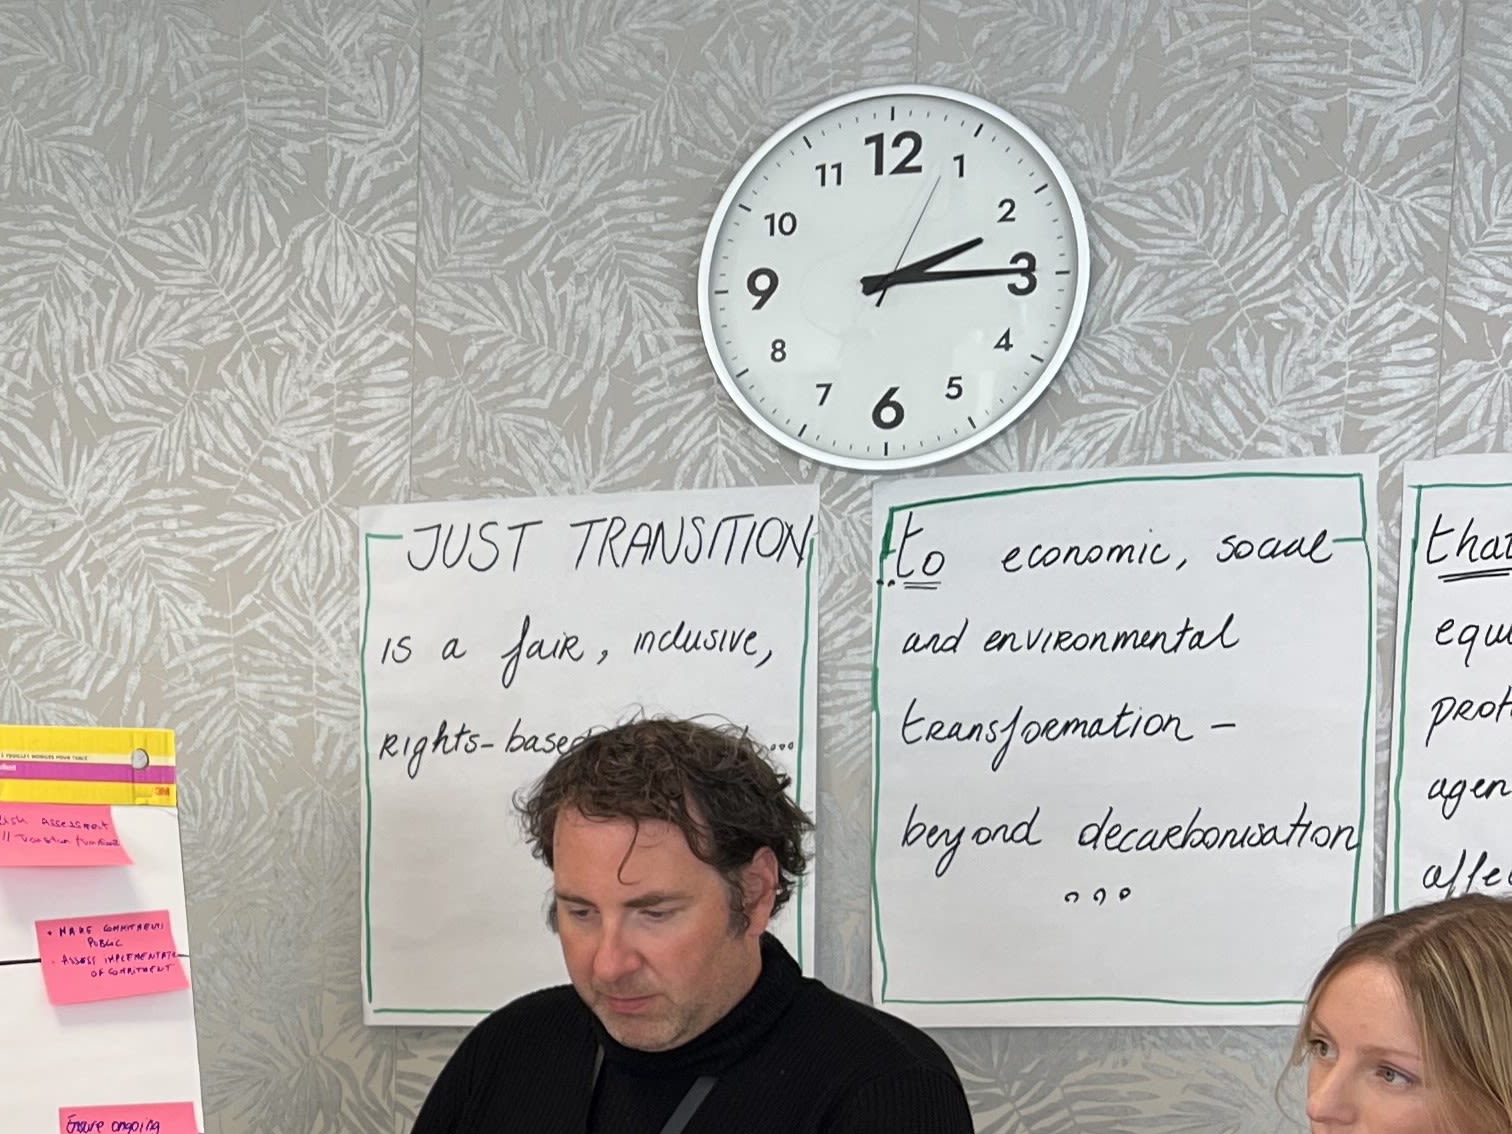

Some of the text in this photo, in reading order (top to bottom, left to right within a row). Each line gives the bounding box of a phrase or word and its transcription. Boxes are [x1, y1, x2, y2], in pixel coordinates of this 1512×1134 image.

[864, 131, 923, 176] 12
[953, 154, 965, 178] 1
[814, 162, 843, 188] 11
[763, 211, 797, 237] 10
[996, 198, 1016, 223] 2
[746, 267, 779, 310] 9
[1007, 251, 1037, 296] 3
[770, 338, 788, 363] 8
[993, 327, 1014, 352] 4
[815, 382, 833, 406] 7
[944, 375, 964, 400] 5
[871, 386, 905, 430] 6
[406, 513, 814, 574] JUST TRANSITION
[1001, 526, 1189, 574] economic,
[440, 635, 467, 662] a
[900, 616, 970, 656] and
[1435, 617, 1512, 669] equ
[1424, 684, 1512, 749] prot
[899, 803, 1043, 878] beyond
